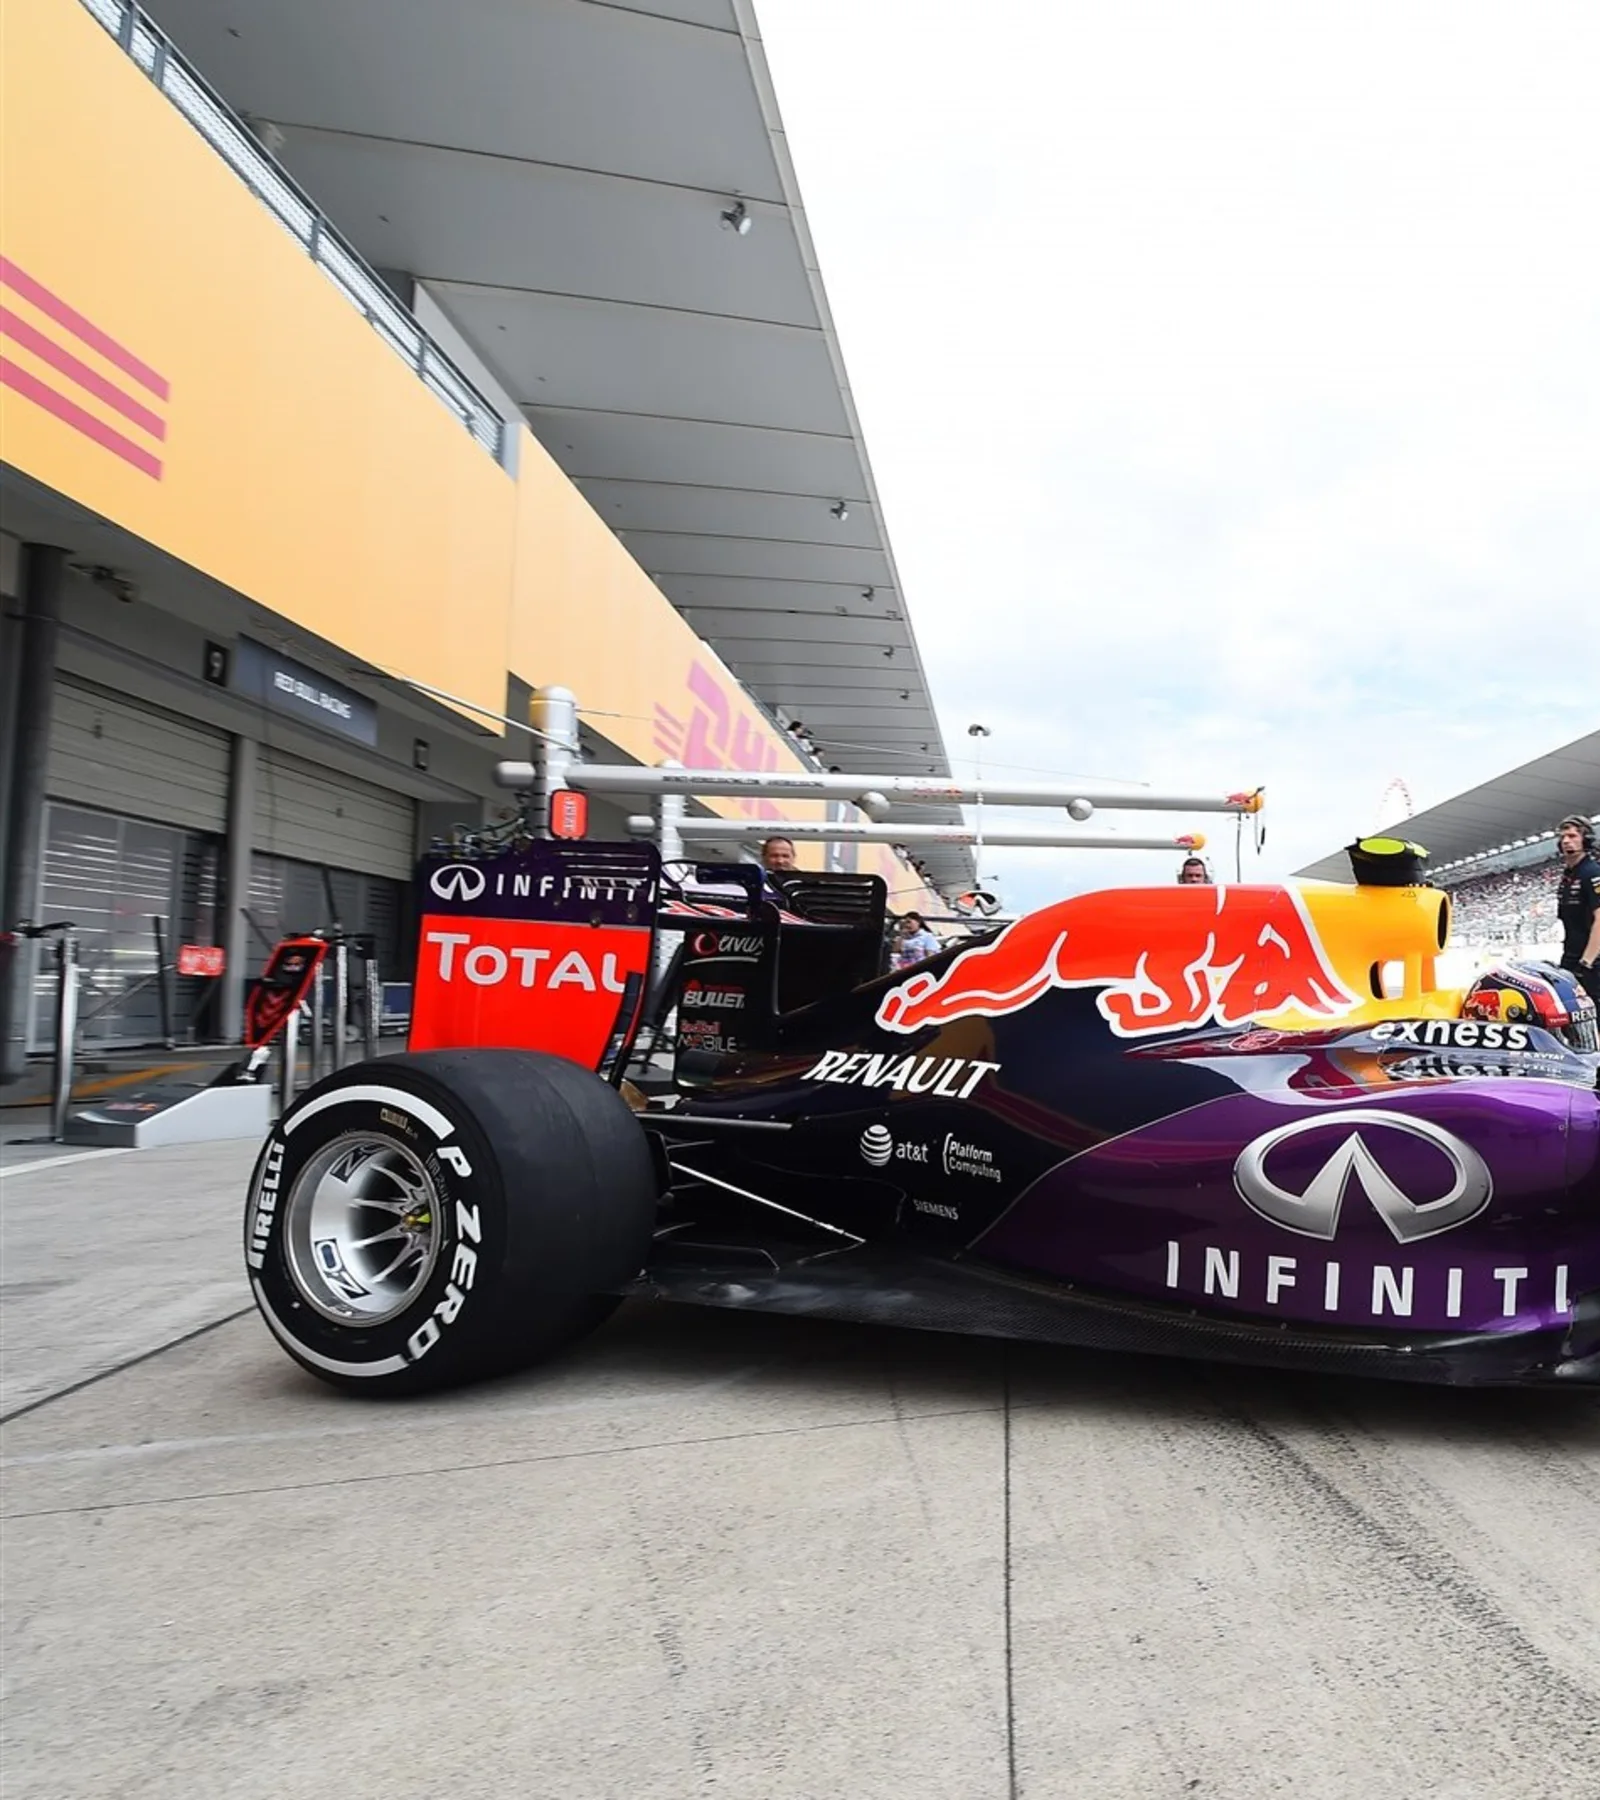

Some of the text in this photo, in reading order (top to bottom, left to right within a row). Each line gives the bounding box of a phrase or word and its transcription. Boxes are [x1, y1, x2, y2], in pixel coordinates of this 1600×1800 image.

[426, 932, 626, 994] TOTAL
[1370, 1020, 1528, 1050] exness
[800, 1050, 1001, 1099] RENAULT
[895, 1141, 929, 1164] at&t
[948, 1156, 1002, 1183] Computing
[949, 1140, 993, 1163] Platform
[249, 1138, 285, 1270] PIRELLI
[912, 1198, 959, 1220] SIEMENS
[408, 1146, 482, 1362] P ZERO
[1166, 1240, 1570, 1318] INFINITI
